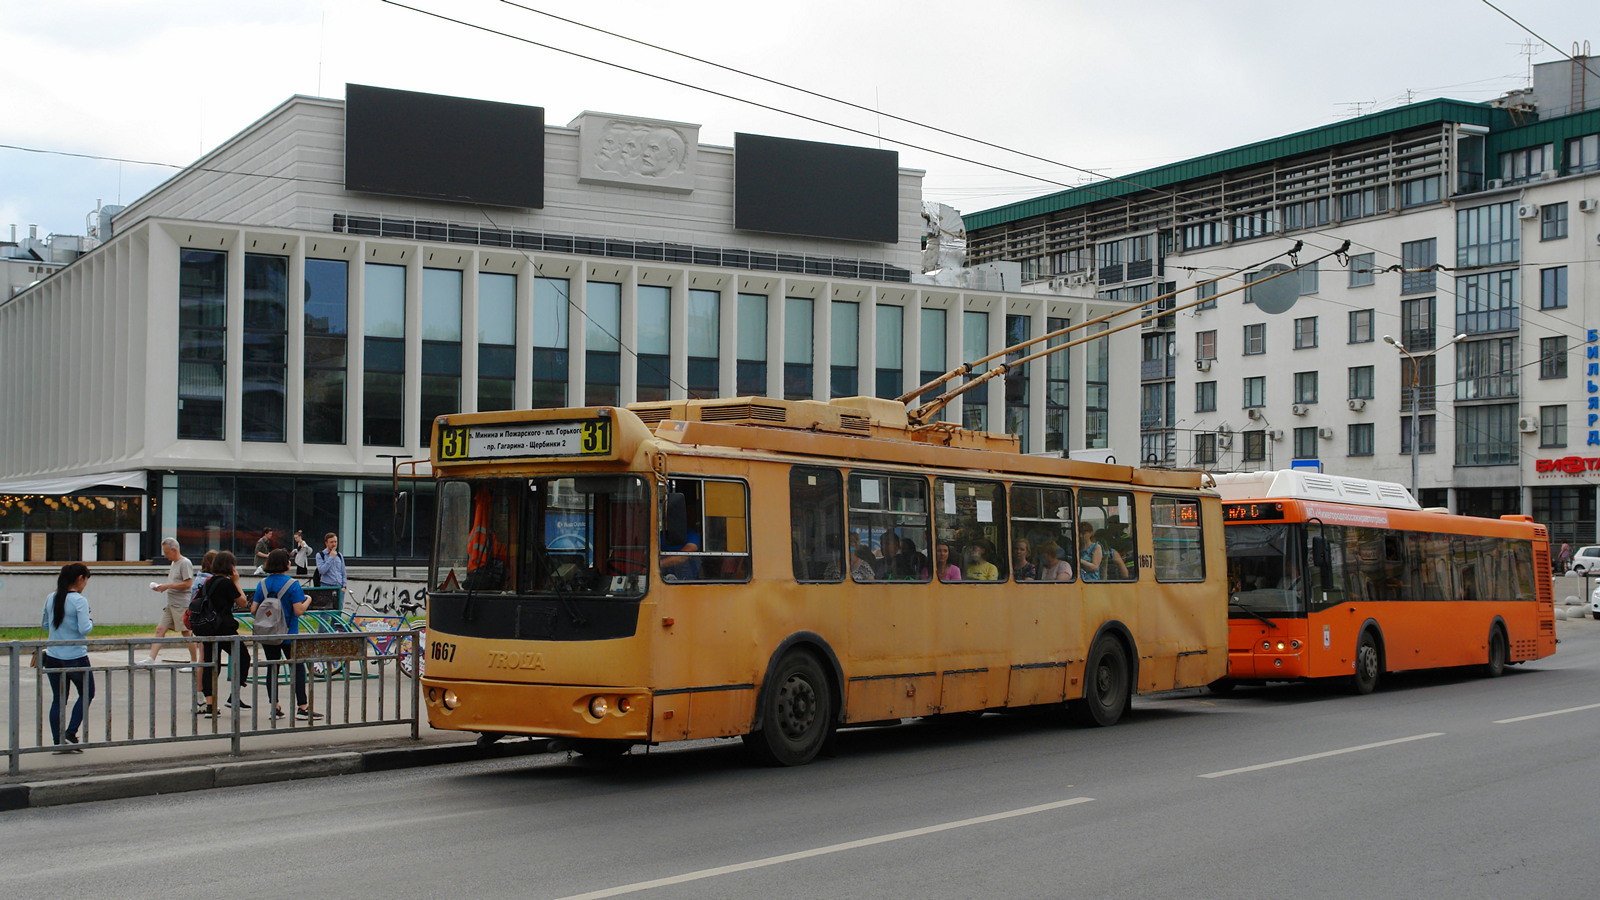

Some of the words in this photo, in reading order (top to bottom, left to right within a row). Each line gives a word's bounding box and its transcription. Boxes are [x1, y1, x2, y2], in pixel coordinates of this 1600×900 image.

[1587, 329, 1600, 446] БИЛЬЯРД
[445, 428, 467, 456] 31
[475, 431, 498, 439] Минина
[505, 429, 541, 439] Пожарского
[497, 442, 525, 450] Гагарина
[529, 440, 561, 450] Щербинки
[584, 422, 608, 451] 31
[1139, 554, 1153, 569] 1667
[431, 641, 457, 663] 1667
